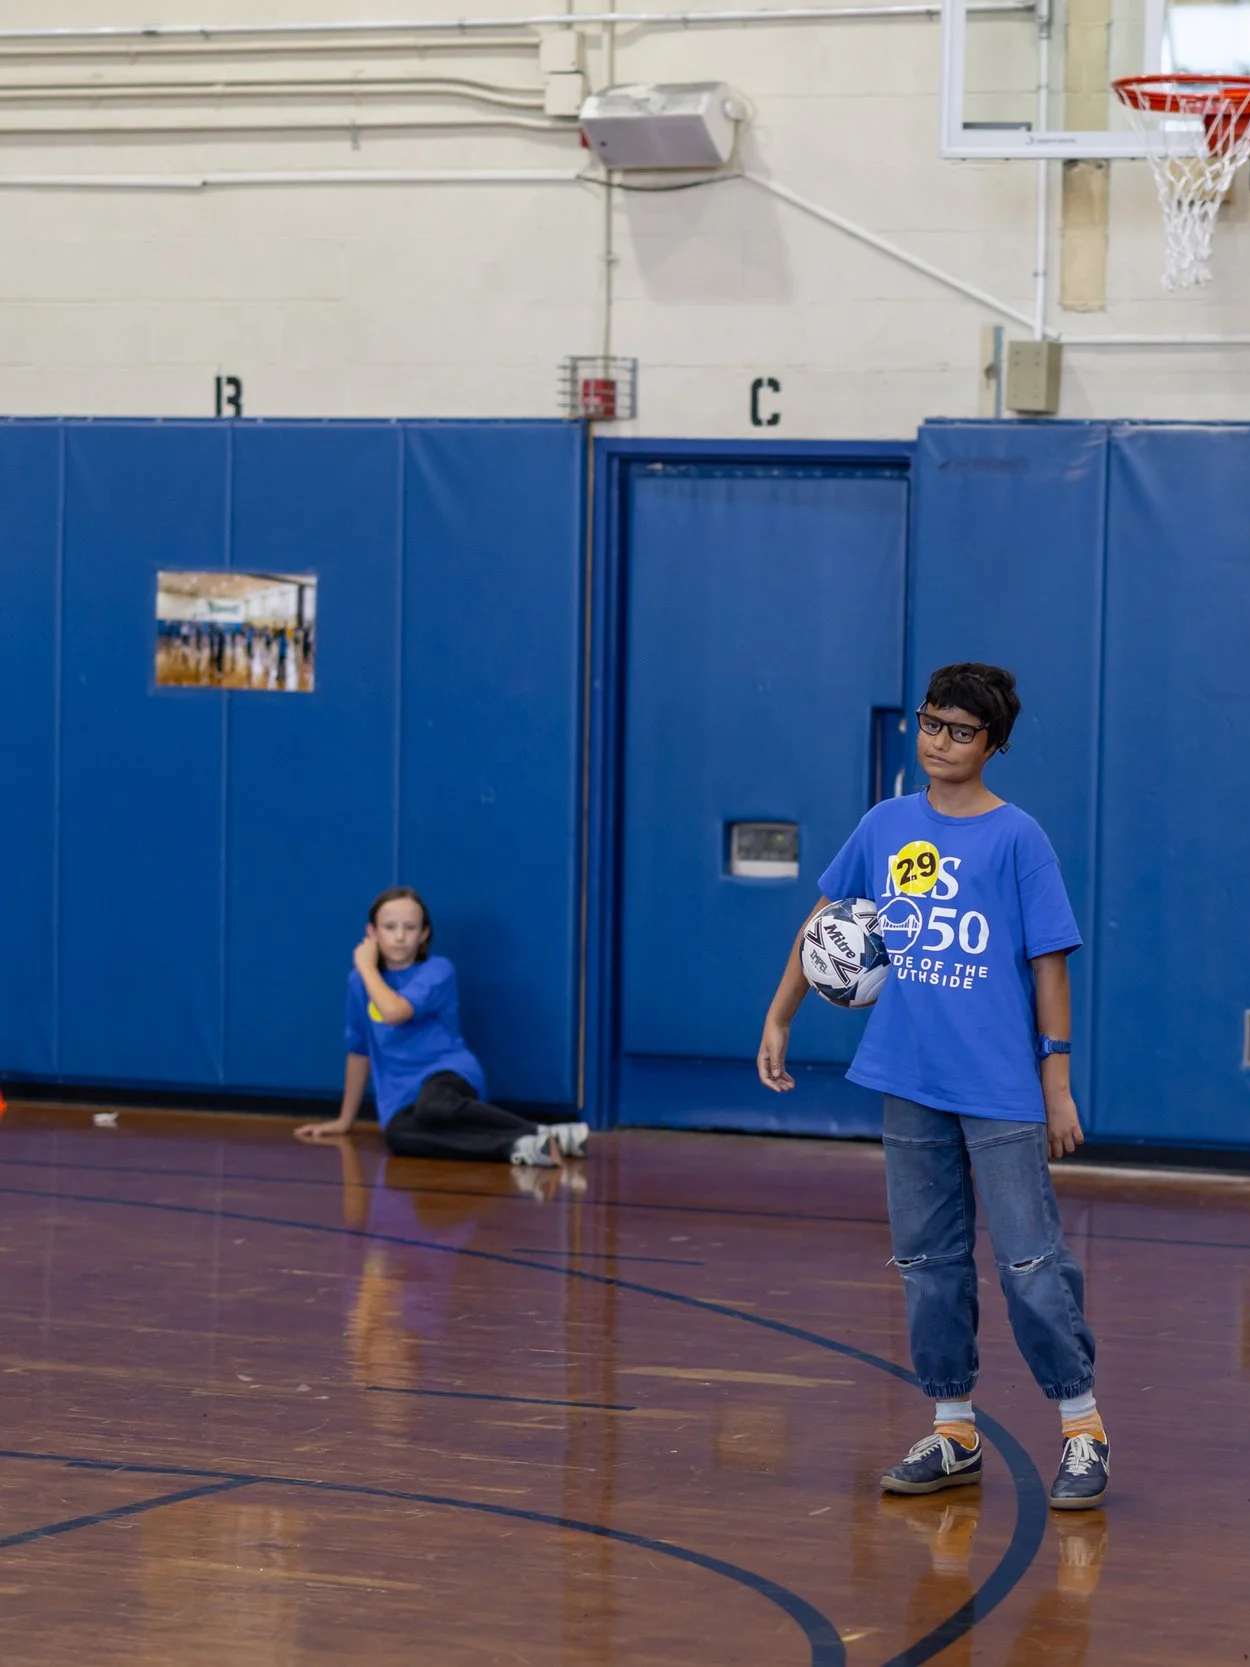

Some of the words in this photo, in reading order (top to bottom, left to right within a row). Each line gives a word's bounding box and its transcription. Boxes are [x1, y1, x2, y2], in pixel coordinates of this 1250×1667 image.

[751, 377, 780, 427] C
[897, 852, 936, 886] 29
[823, 923, 857, 959] Mitre
[922, 906, 990, 955] 50
[897, 966, 974, 990] UTHSIDE
[921, 957, 945, 972] OF
[954, 963, 989, 979] THE
